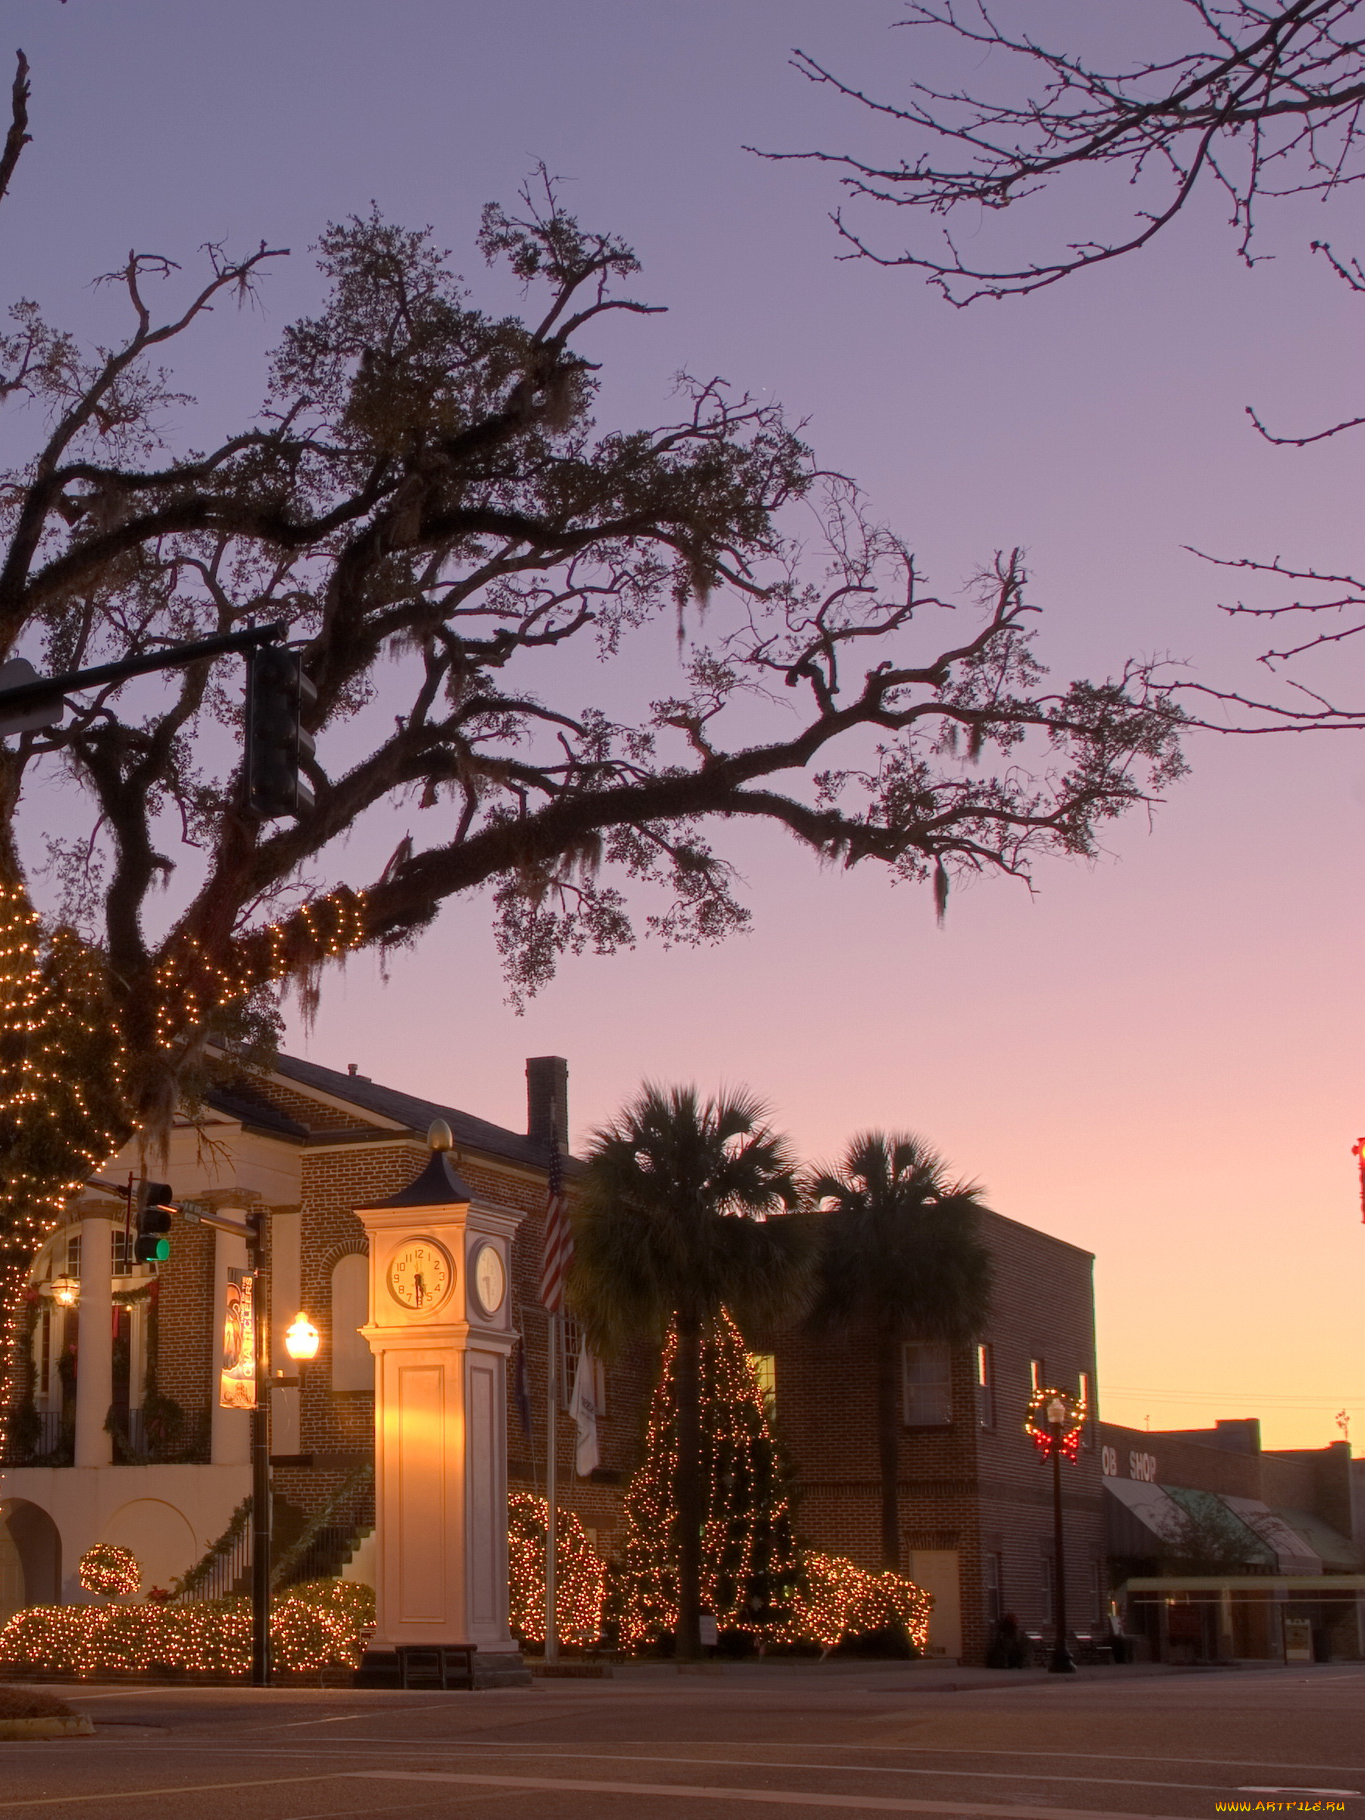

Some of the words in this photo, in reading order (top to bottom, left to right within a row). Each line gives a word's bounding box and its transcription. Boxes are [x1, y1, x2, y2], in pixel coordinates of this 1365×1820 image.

[405, 1253, 412, 1263] 11
[415, 1249, 424, 1259] 12
[396, 1262, 406, 1272] 10
[434, 1260, 440, 1270] 2
[393, 1273, 400, 1283] 9
[438, 1271, 445, 1281] 3
[398, 1285, 404, 1294] 8
[434, 1283, 441, 1292] 4
[406, 1292, 412, 1303] 7
[426, 1292, 433, 1302] 5
[1130, 1450, 1156, 1483] SHOP
